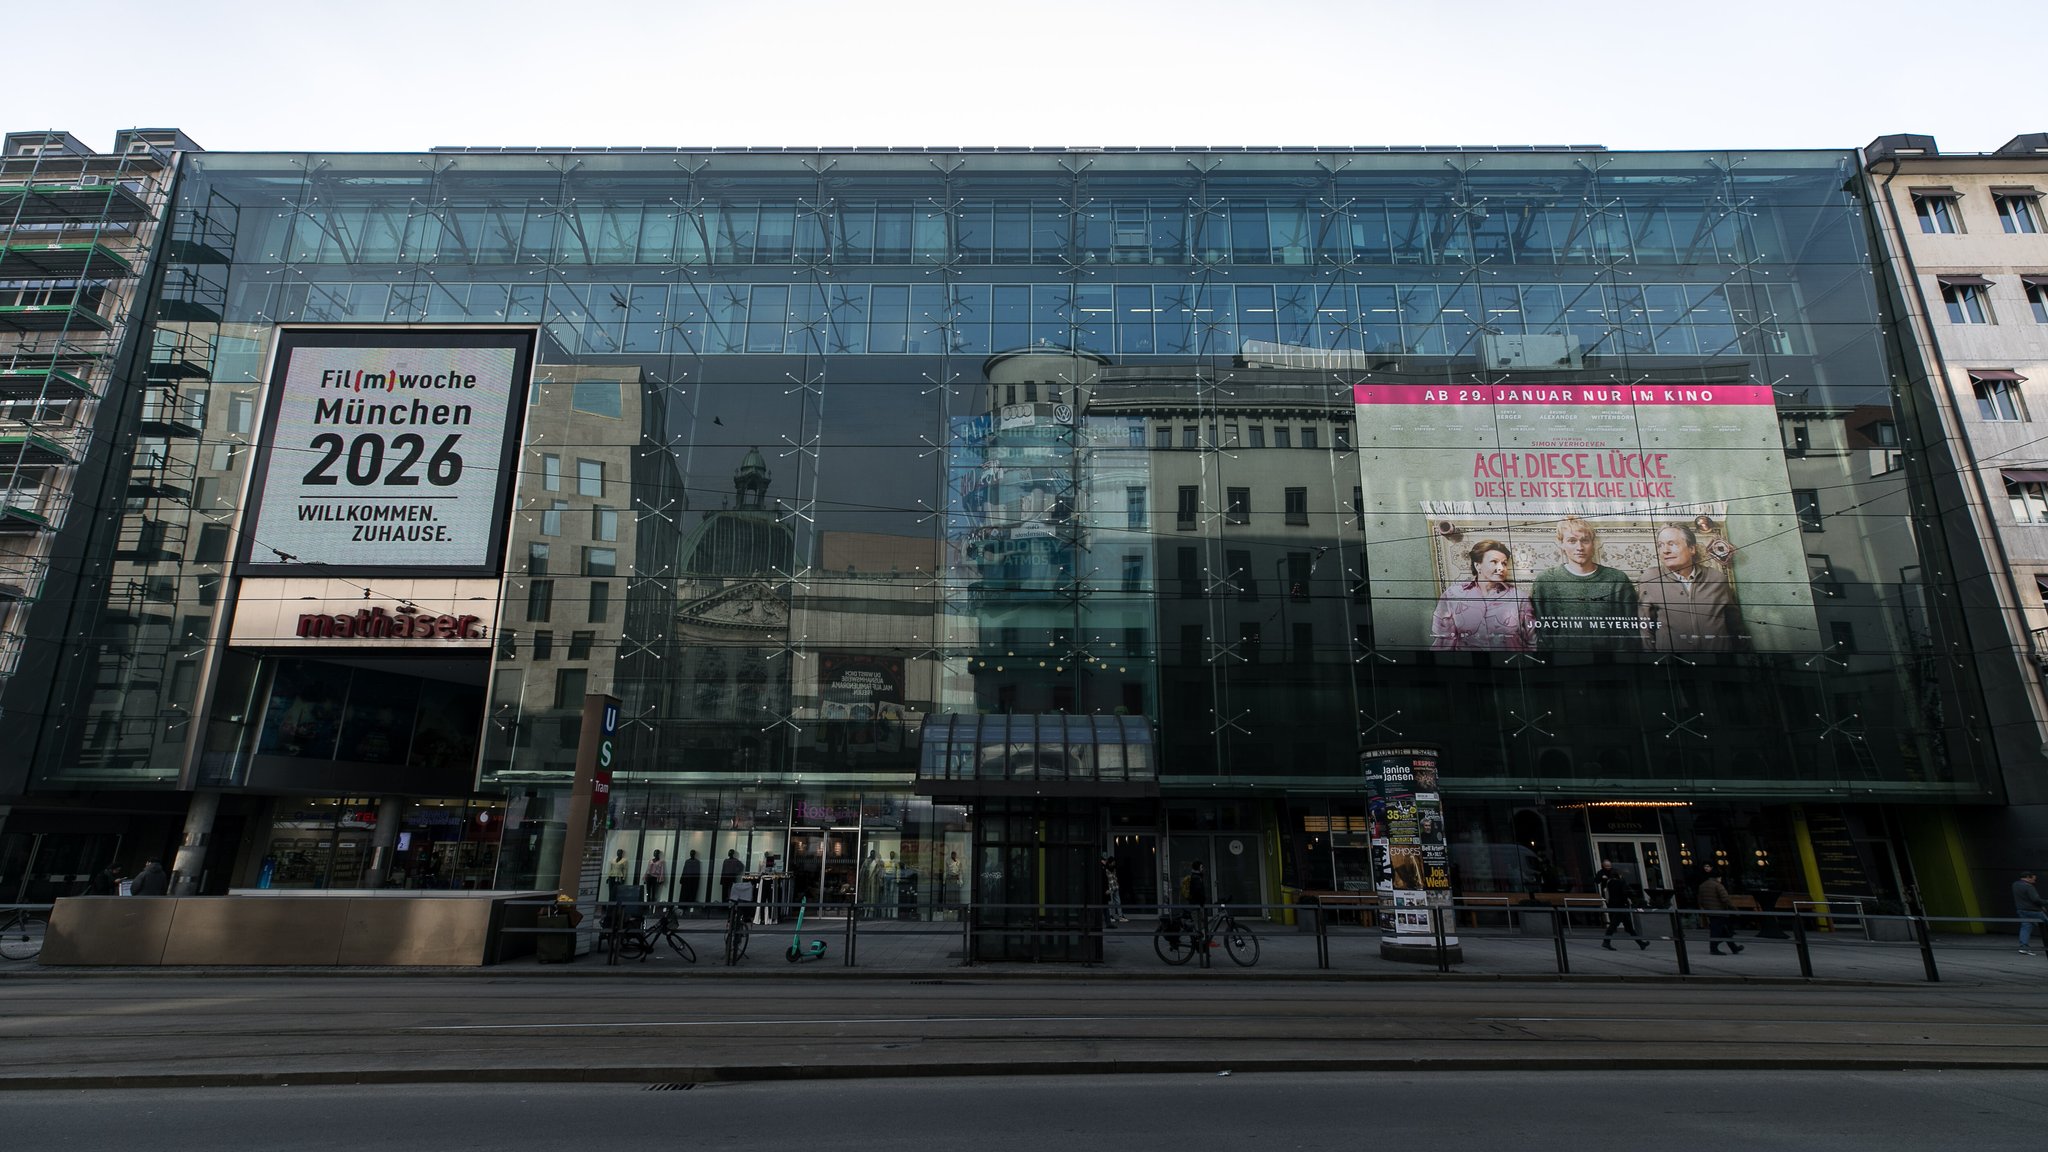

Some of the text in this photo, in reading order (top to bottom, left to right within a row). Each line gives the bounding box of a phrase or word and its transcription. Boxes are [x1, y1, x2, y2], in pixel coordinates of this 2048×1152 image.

[320, 369, 476, 393] Fil(m)woche
[1425, 390, 1713, 402] AB 29. JANUAR NUR IM KINO
[313, 398, 472, 425] München
[302, 433, 463, 486] 2026
[1473, 450, 1676, 479] ACH, DIESE LÜCKE.
[1474, 481, 1517, 498] DIESE
[1520, 481, 1628, 498] ENTSETZLICHE
[298, 504, 439, 522] WILLKOMMEN.
[352, 525, 453, 542] ZUHAUSE.
[1527, 620, 1663, 630] JOACHIM MEYERHOFF
[606, 707, 616, 731] U
[601, 741, 612, 766] S
[1383, 764, 1411, 775] Janine
[1383, 773, 1414, 782] Jansen
[595, 780, 609, 793] Tram
[1386, 810, 1399, 820] 35
